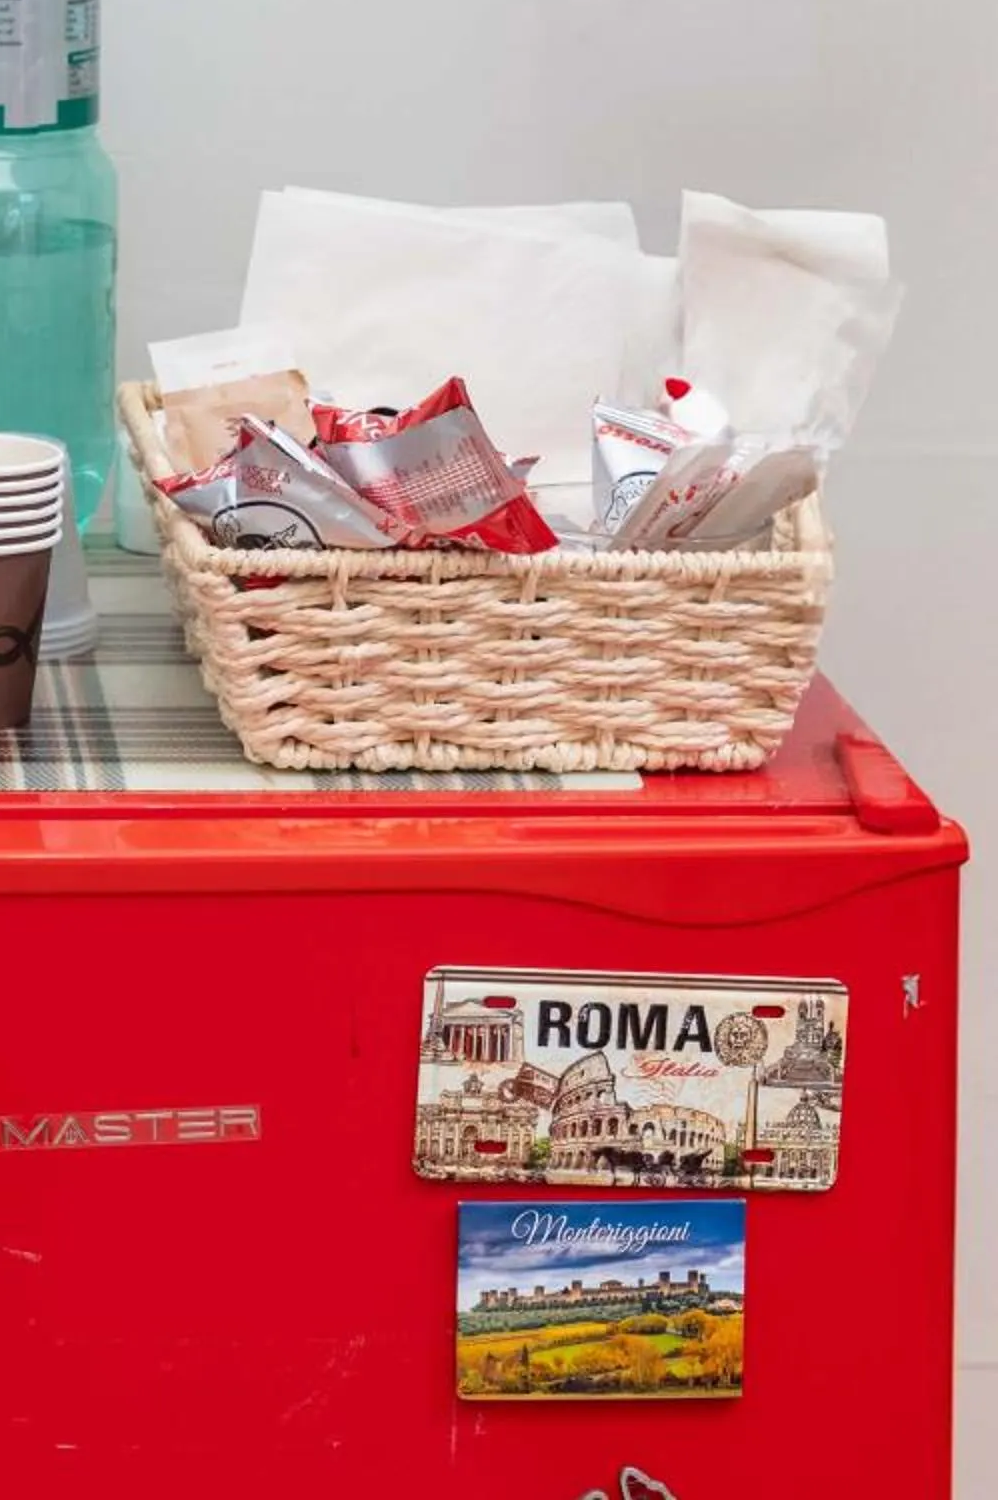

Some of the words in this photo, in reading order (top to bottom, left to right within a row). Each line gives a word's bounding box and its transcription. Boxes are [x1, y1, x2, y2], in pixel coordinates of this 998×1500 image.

[537, 1000, 713, 1053] ROMA
[621, 1056, 720, 1079] Italia
[2, 1107, 258, 1147] MASTER
[511, 1209, 691, 1252] Monteriggioni
